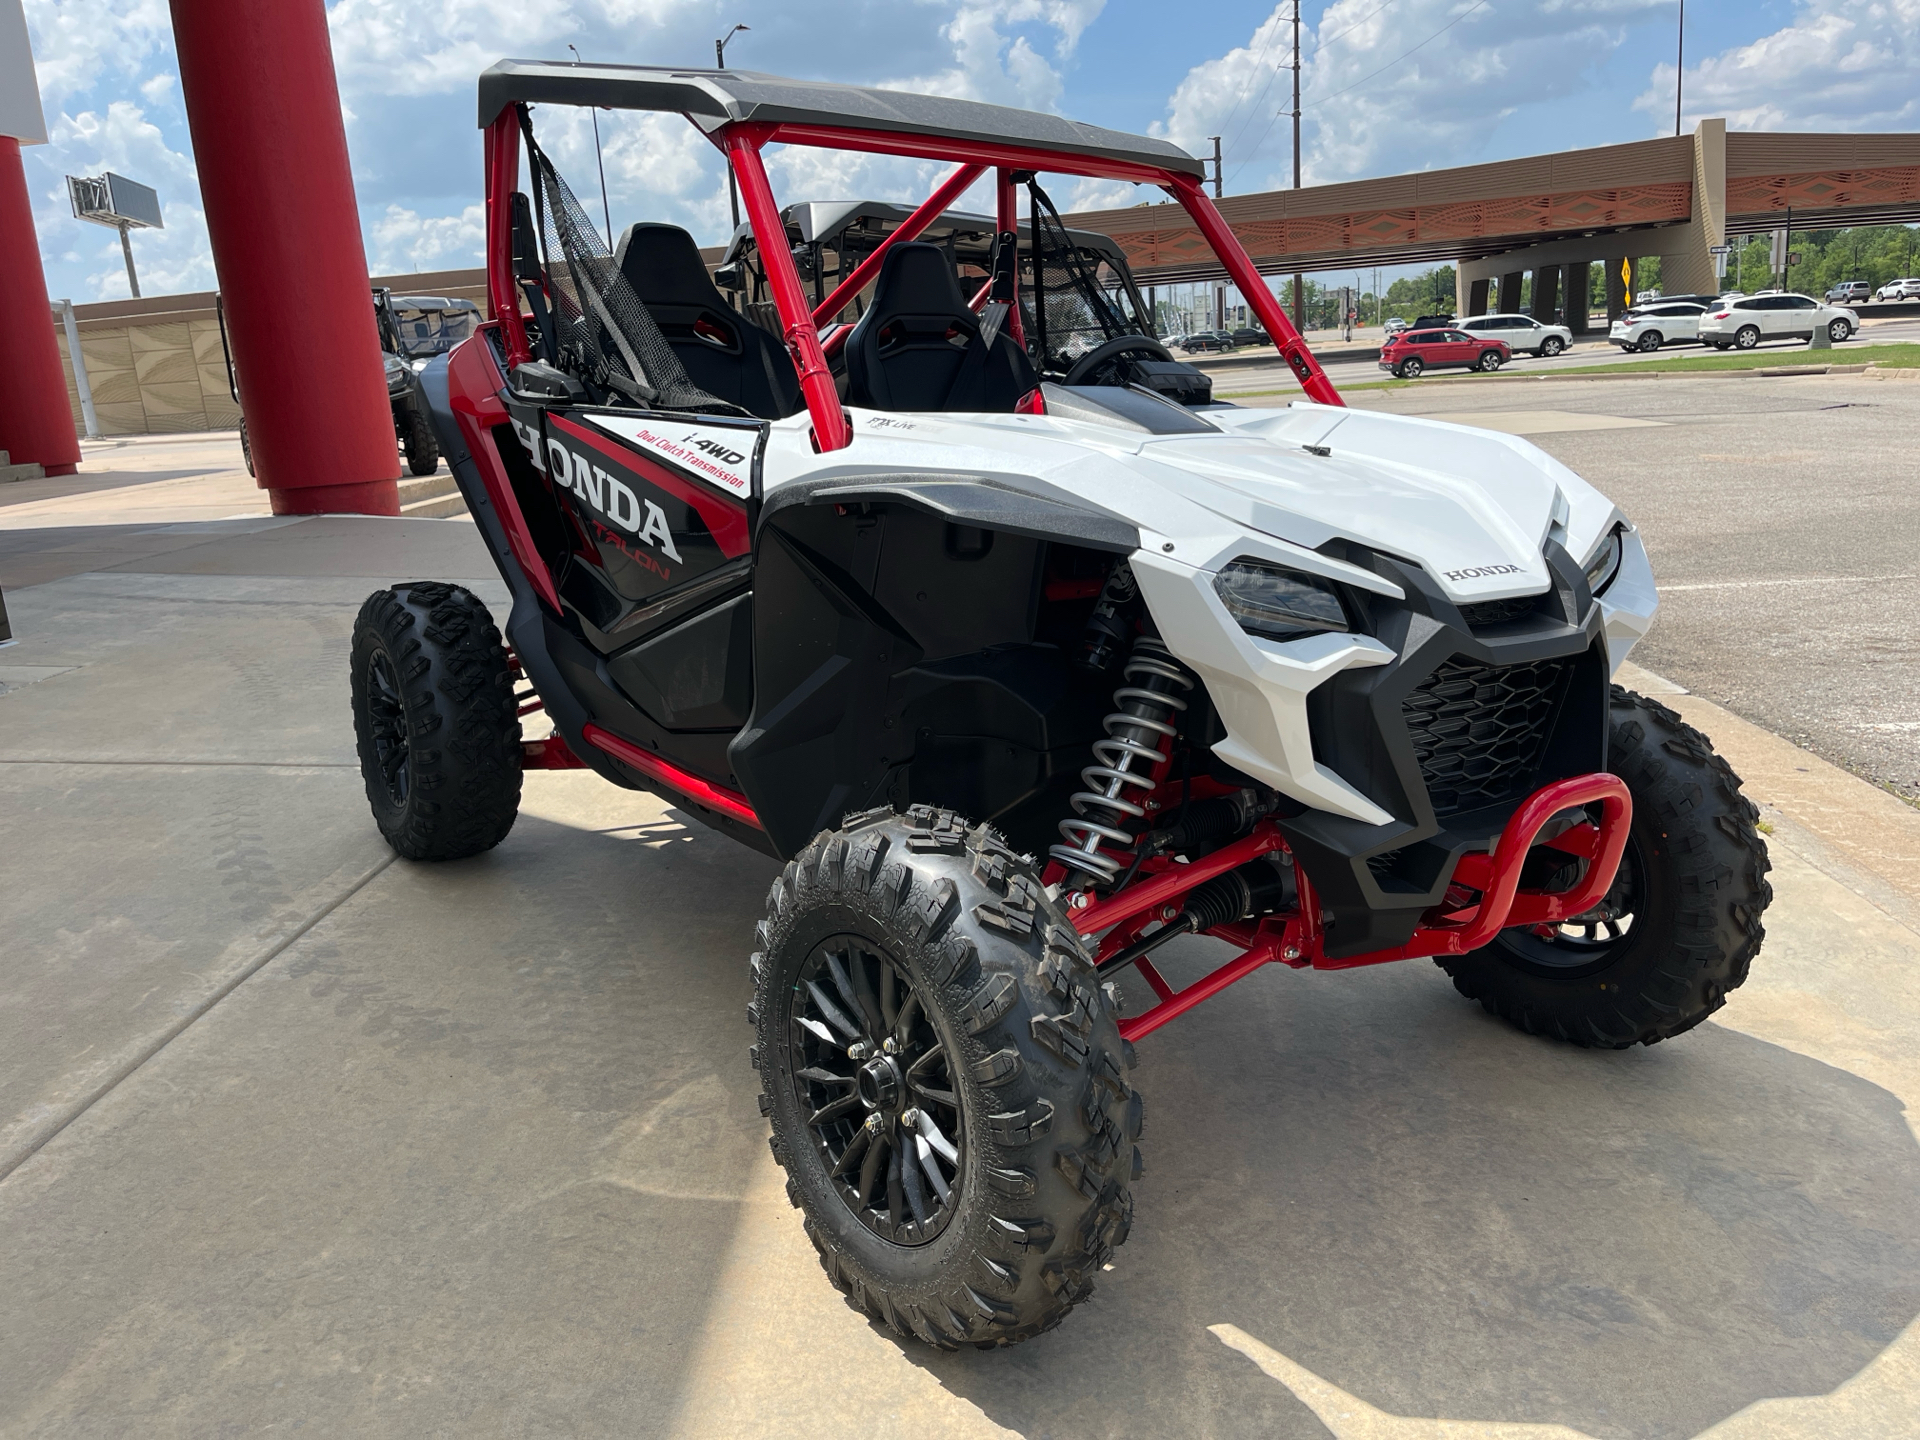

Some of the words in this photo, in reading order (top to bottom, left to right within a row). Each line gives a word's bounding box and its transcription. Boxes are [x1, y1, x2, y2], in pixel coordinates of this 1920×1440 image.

[636, 429, 661, 444] Dual
[654, 438, 686, 458] Clutch
[681, 450, 745, 489] Transmission
[508, 415, 683, 565] HONDA
[592, 519, 671, 582] TALON
[1442, 564, 1528, 582] HONDA
